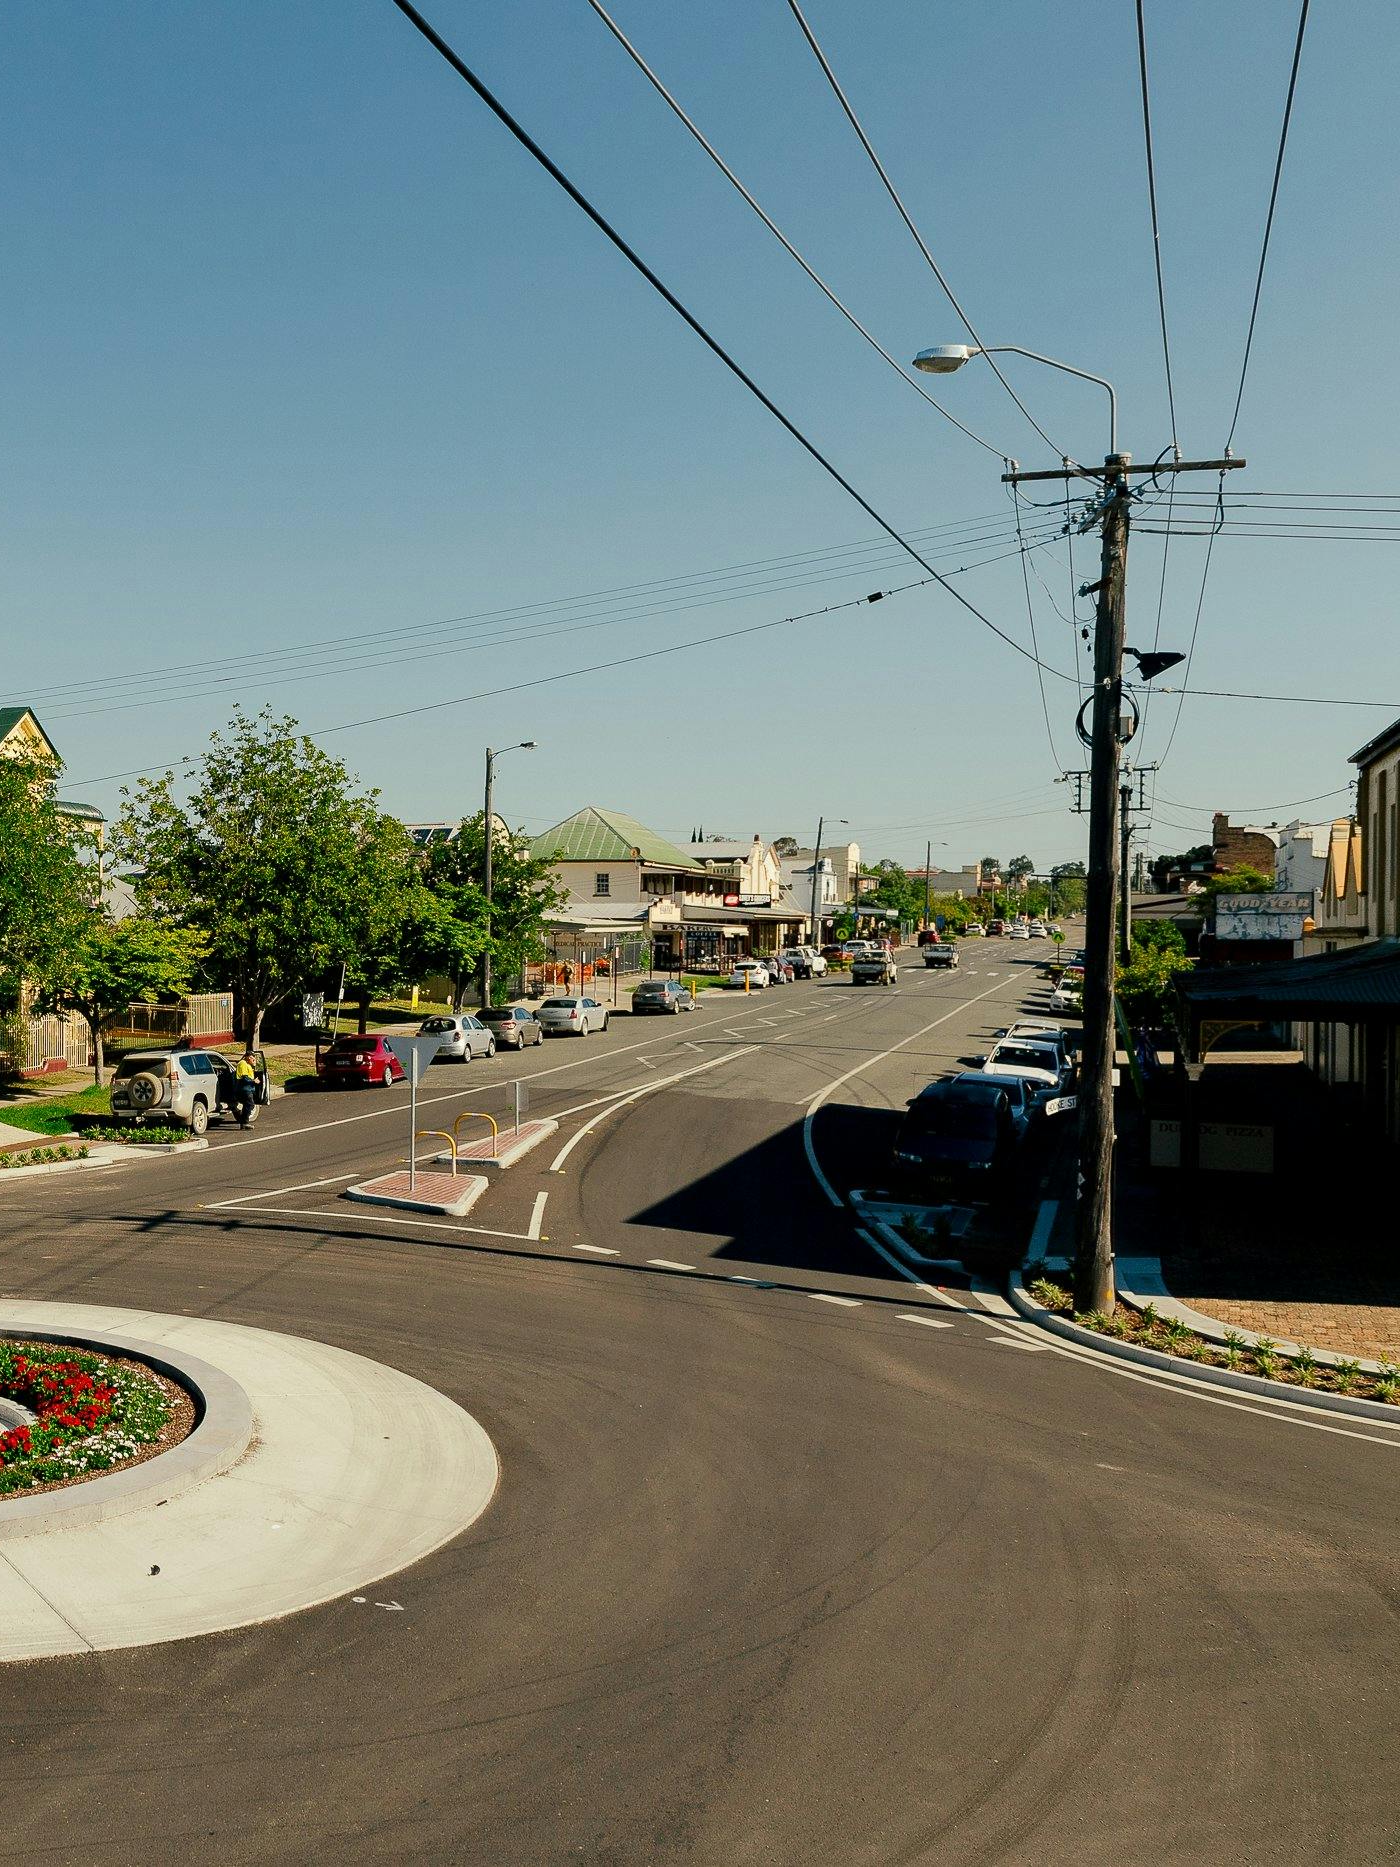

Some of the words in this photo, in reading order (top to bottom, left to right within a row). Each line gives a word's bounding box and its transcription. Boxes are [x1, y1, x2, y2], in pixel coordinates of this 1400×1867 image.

[662, 923, 713, 931] BAKERY
[1067, 1098, 1075, 1107] ST
[1160, 1123, 1218, 1137] DUOG
[1226, 1127, 1264, 1139] PIZZA
